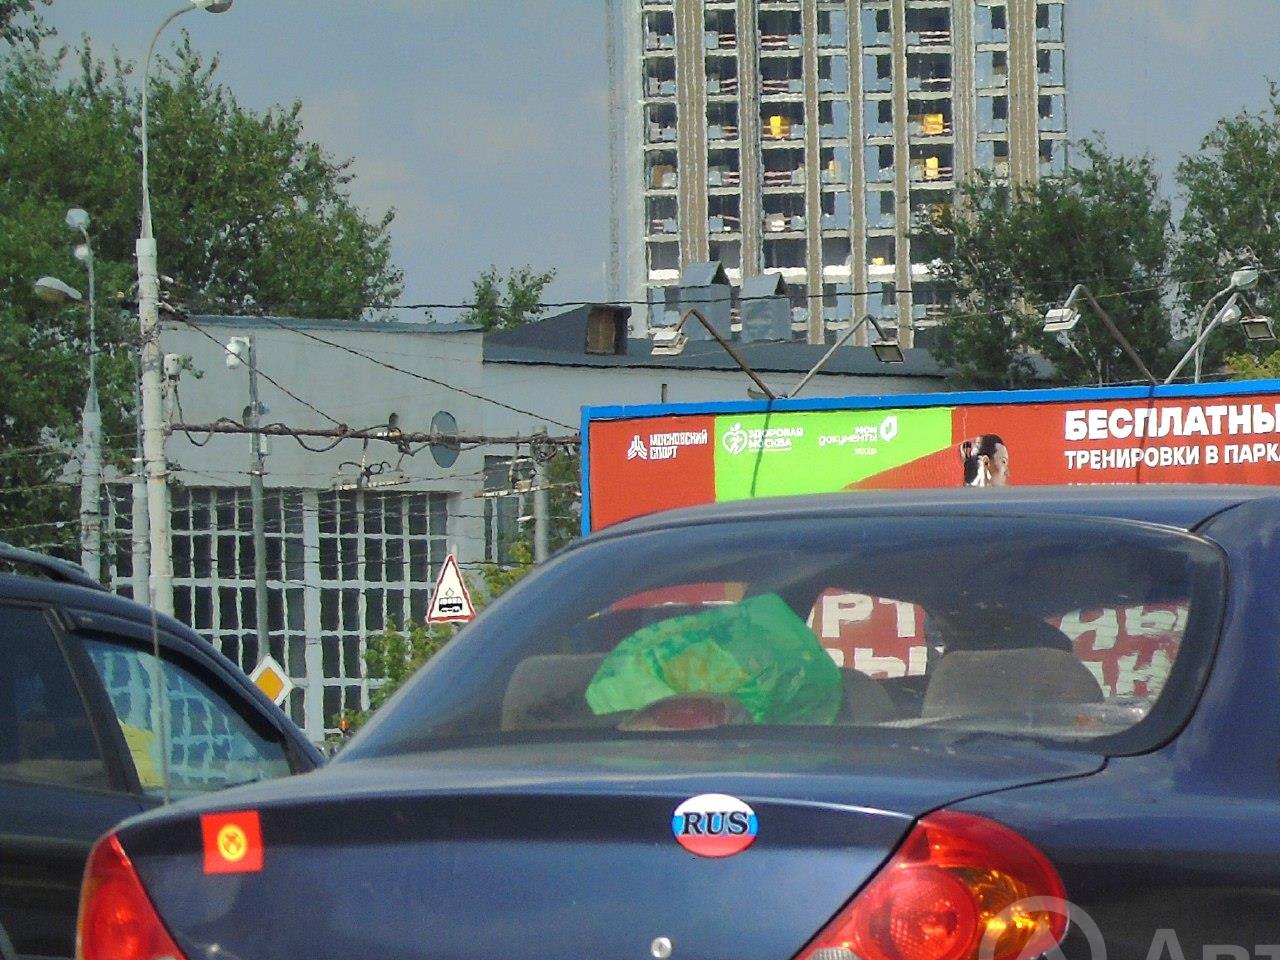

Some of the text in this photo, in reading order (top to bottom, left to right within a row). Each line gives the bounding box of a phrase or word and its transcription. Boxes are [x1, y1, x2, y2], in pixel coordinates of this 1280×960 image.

[649, 429, 708, 447] МОСКОВСКИЙ
[749, 427, 804, 439] ЗДОРОВАЯ
[749, 438, 791, 449] МОСКВА
[649, 446, 678, 460] СПОРТ
[1065, 445, 1199, 470] ТРЕНИРОВКИ
[1205, 447, 1218, 464] В
[682, 811, 748, 835] RUS
